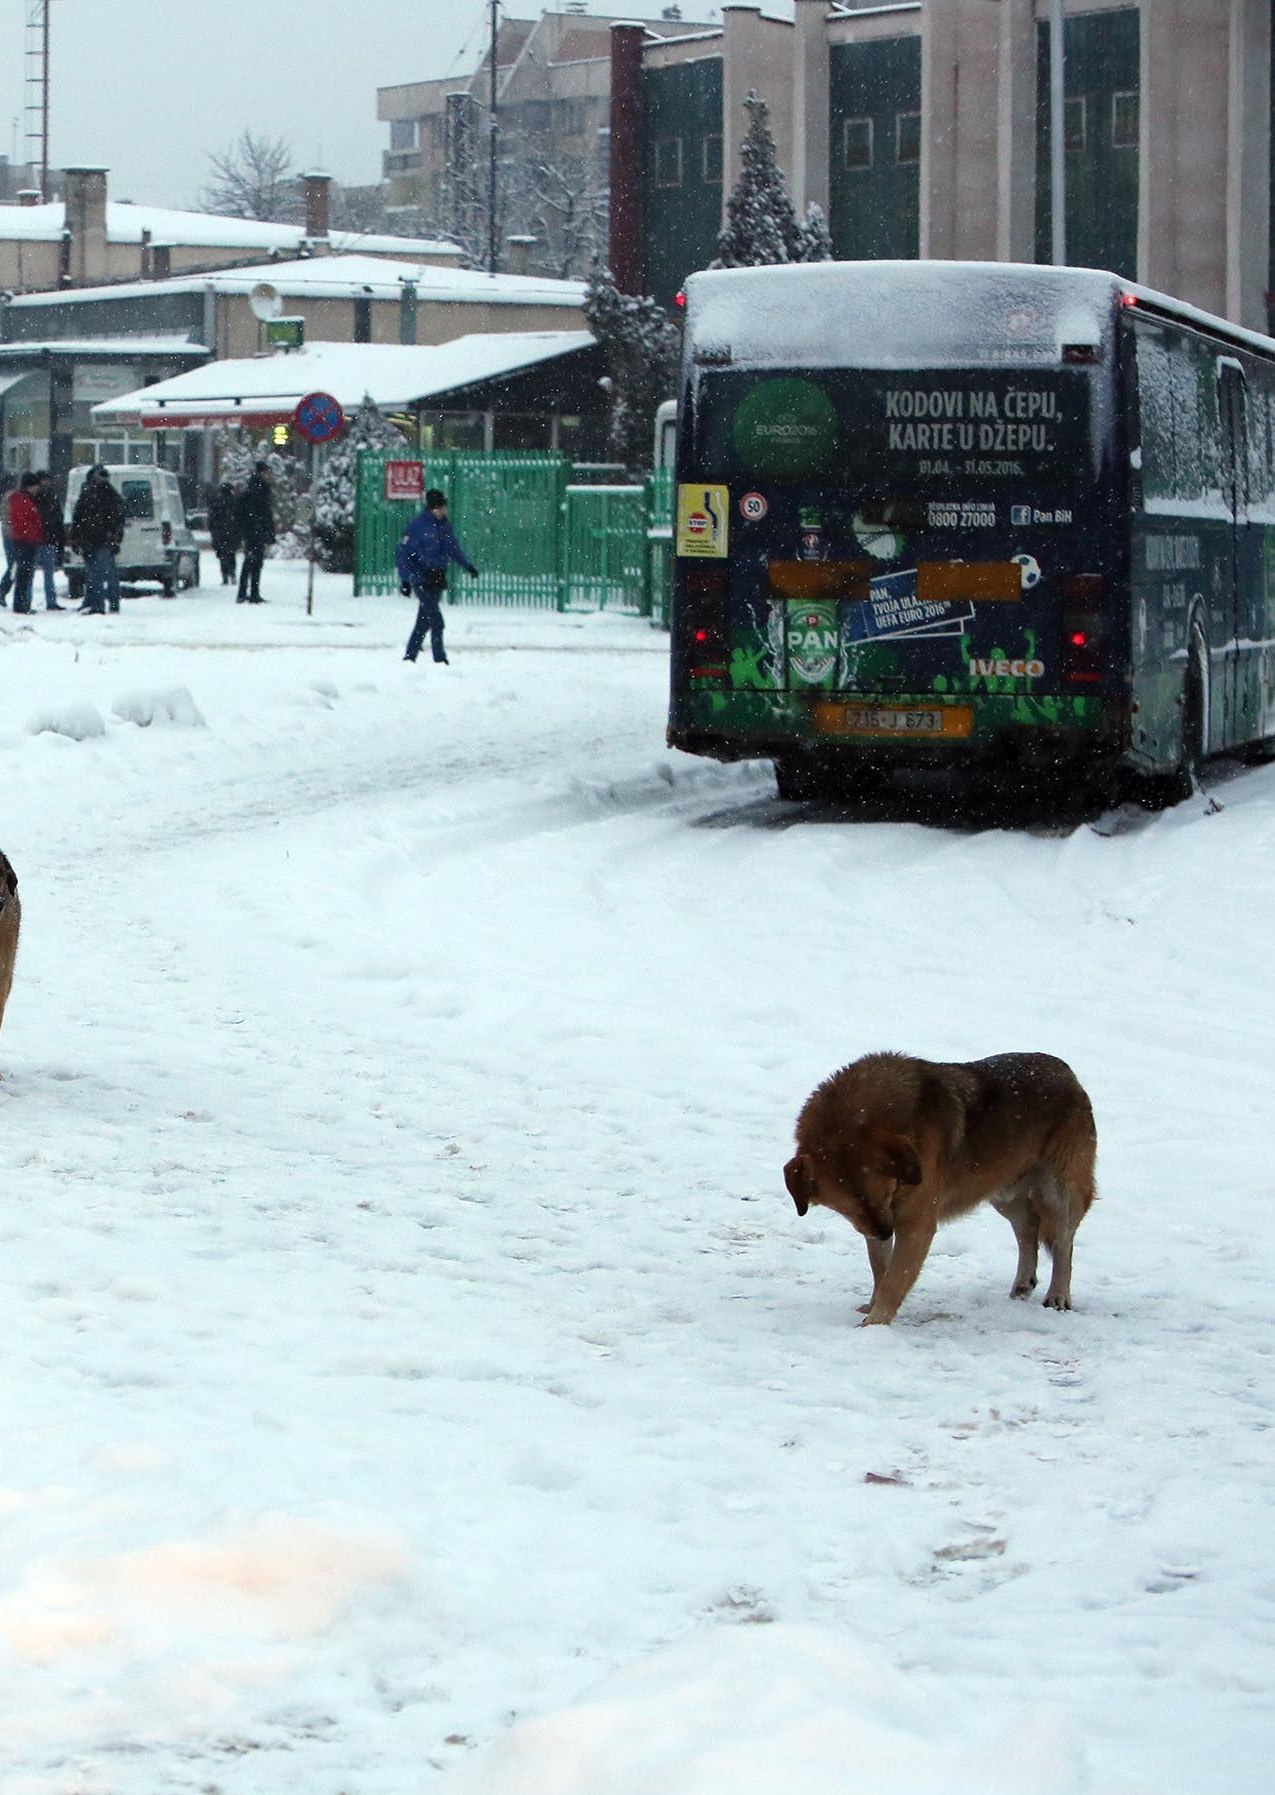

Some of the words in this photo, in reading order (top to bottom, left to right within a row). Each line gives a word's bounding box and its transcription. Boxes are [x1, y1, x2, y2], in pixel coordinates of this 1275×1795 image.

[885, 391, 963, 418] KODOVI
[969, 391, 999, 417] NA
[1003, 385, 1063, 422] ČEPU,
[888, 423, 953, 450] KARTE
[958, 423, 973, 450] U
[979, 418, 1055, 451] DŽEPU.
[747, 501, 760, 513] 50
[688, 519, 708, 527] STOP
[928, 512, 958, 527] 0800
[960, 512, 996, 527] 27000
[1033, 509, 1052, 523] Pan
[1054, 509, 1073, 523] BiH
[872, 599, 901, 616] TVOJA
[875, 613, 899, 629] UEFA
[898, 608, 924, 624] EURO
[787, 631, 838, 650] PAN
[969, 659, 1045, 677] IVECO
